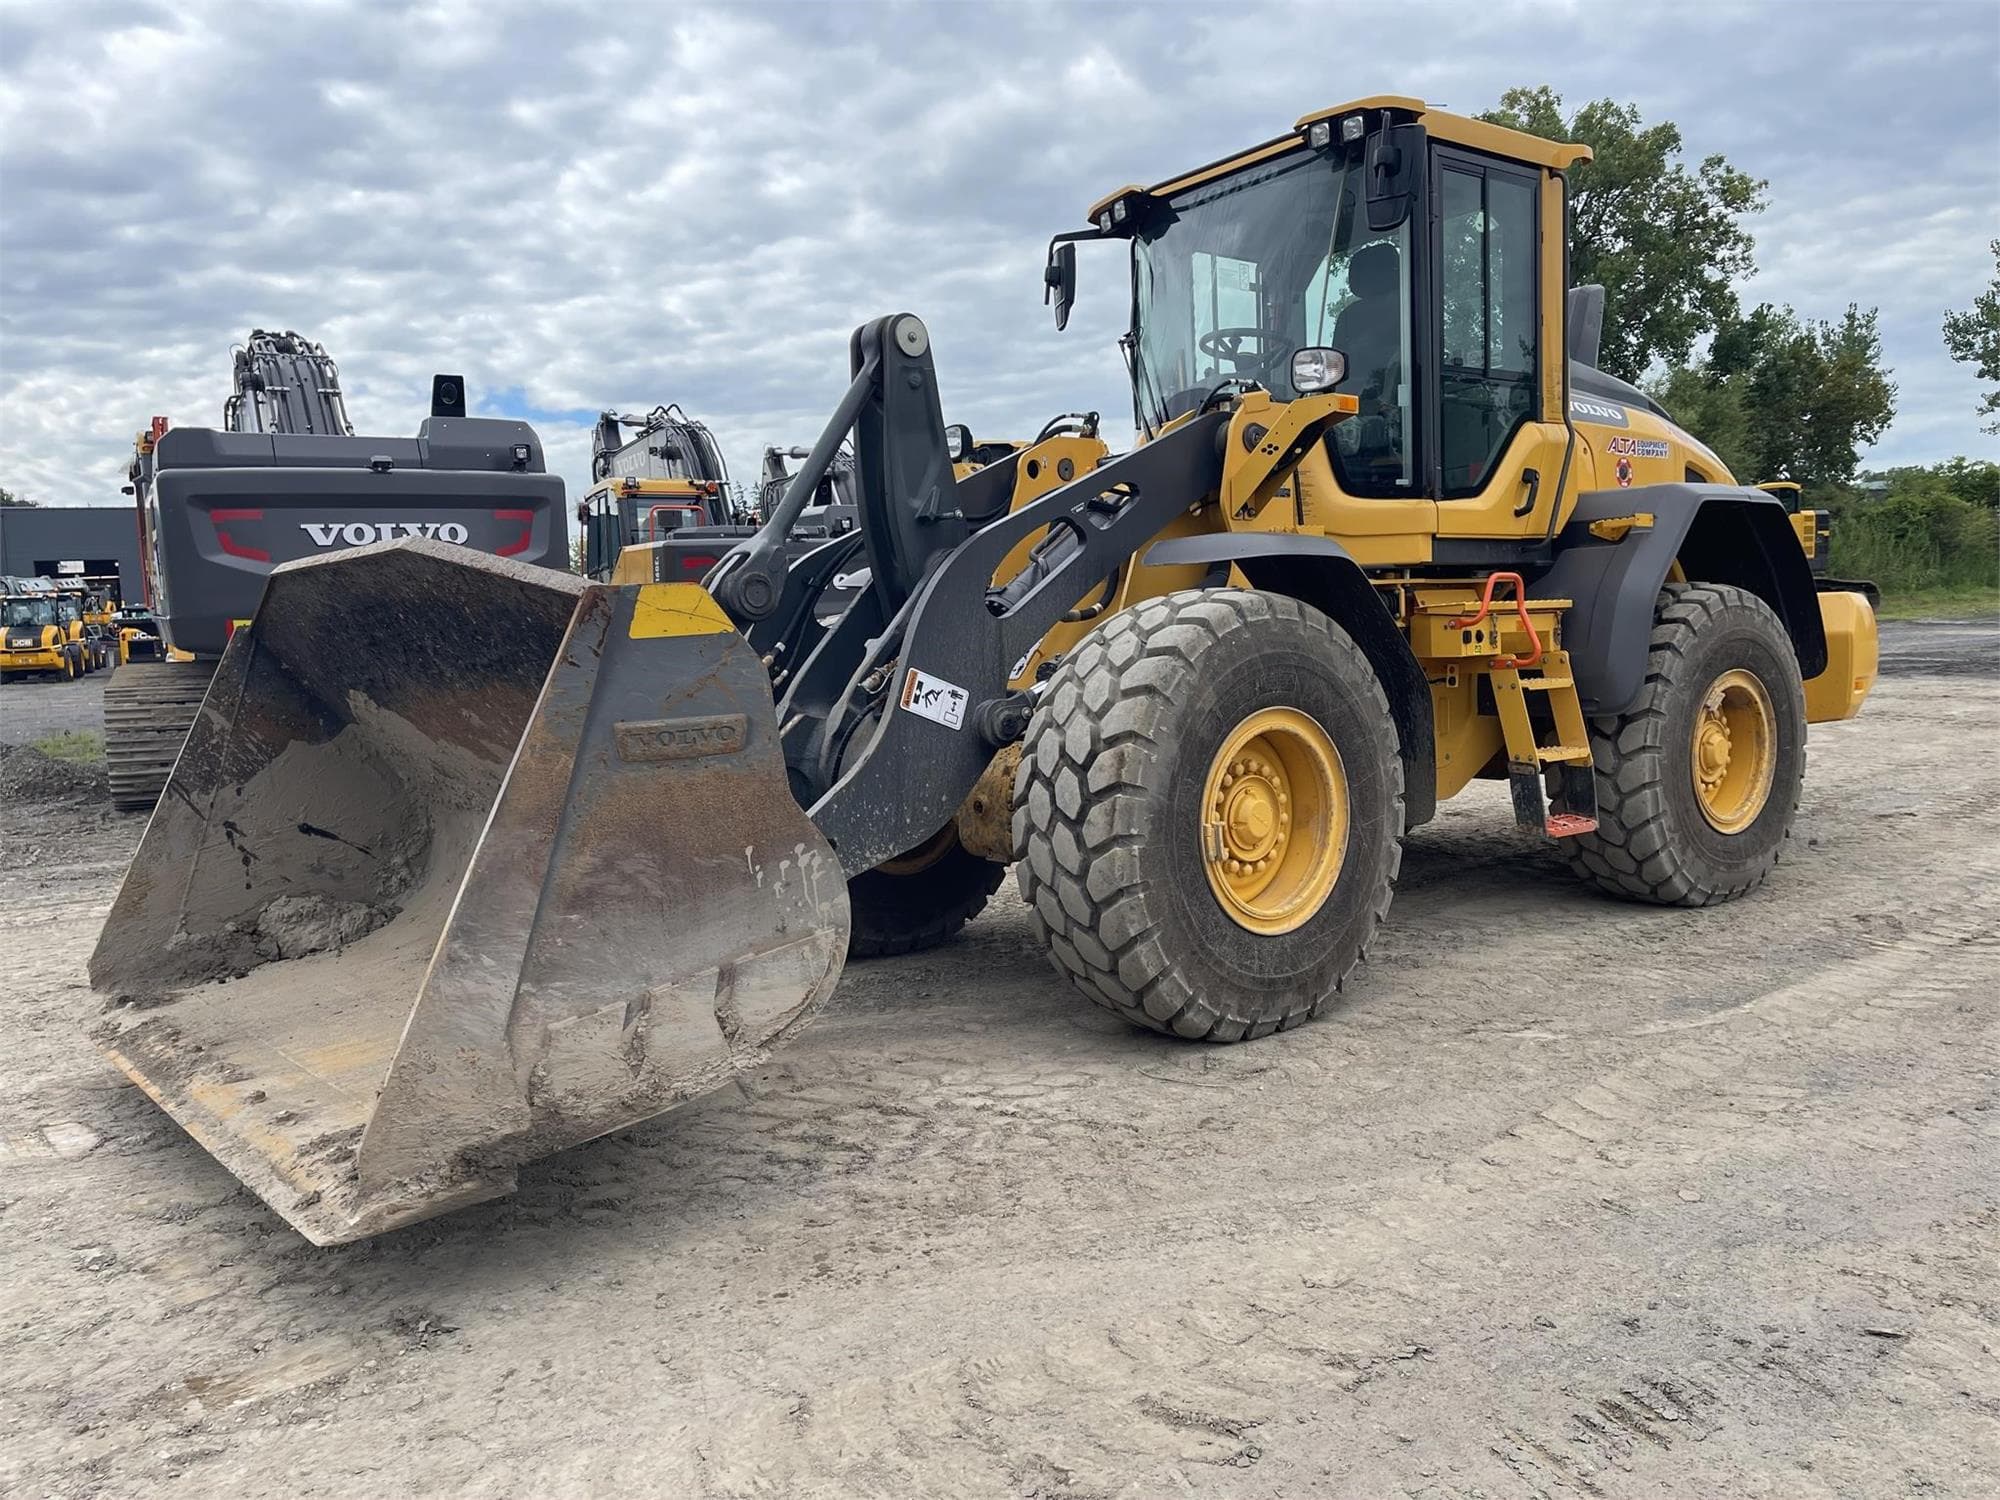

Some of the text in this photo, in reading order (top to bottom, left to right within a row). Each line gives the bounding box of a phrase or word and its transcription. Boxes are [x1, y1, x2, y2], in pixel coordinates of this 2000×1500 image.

[1608, 436, 1637, 456] ALTA
[616, 451, 646, 475] VOLVO
[624, 725, 737, 749] VOLVO
